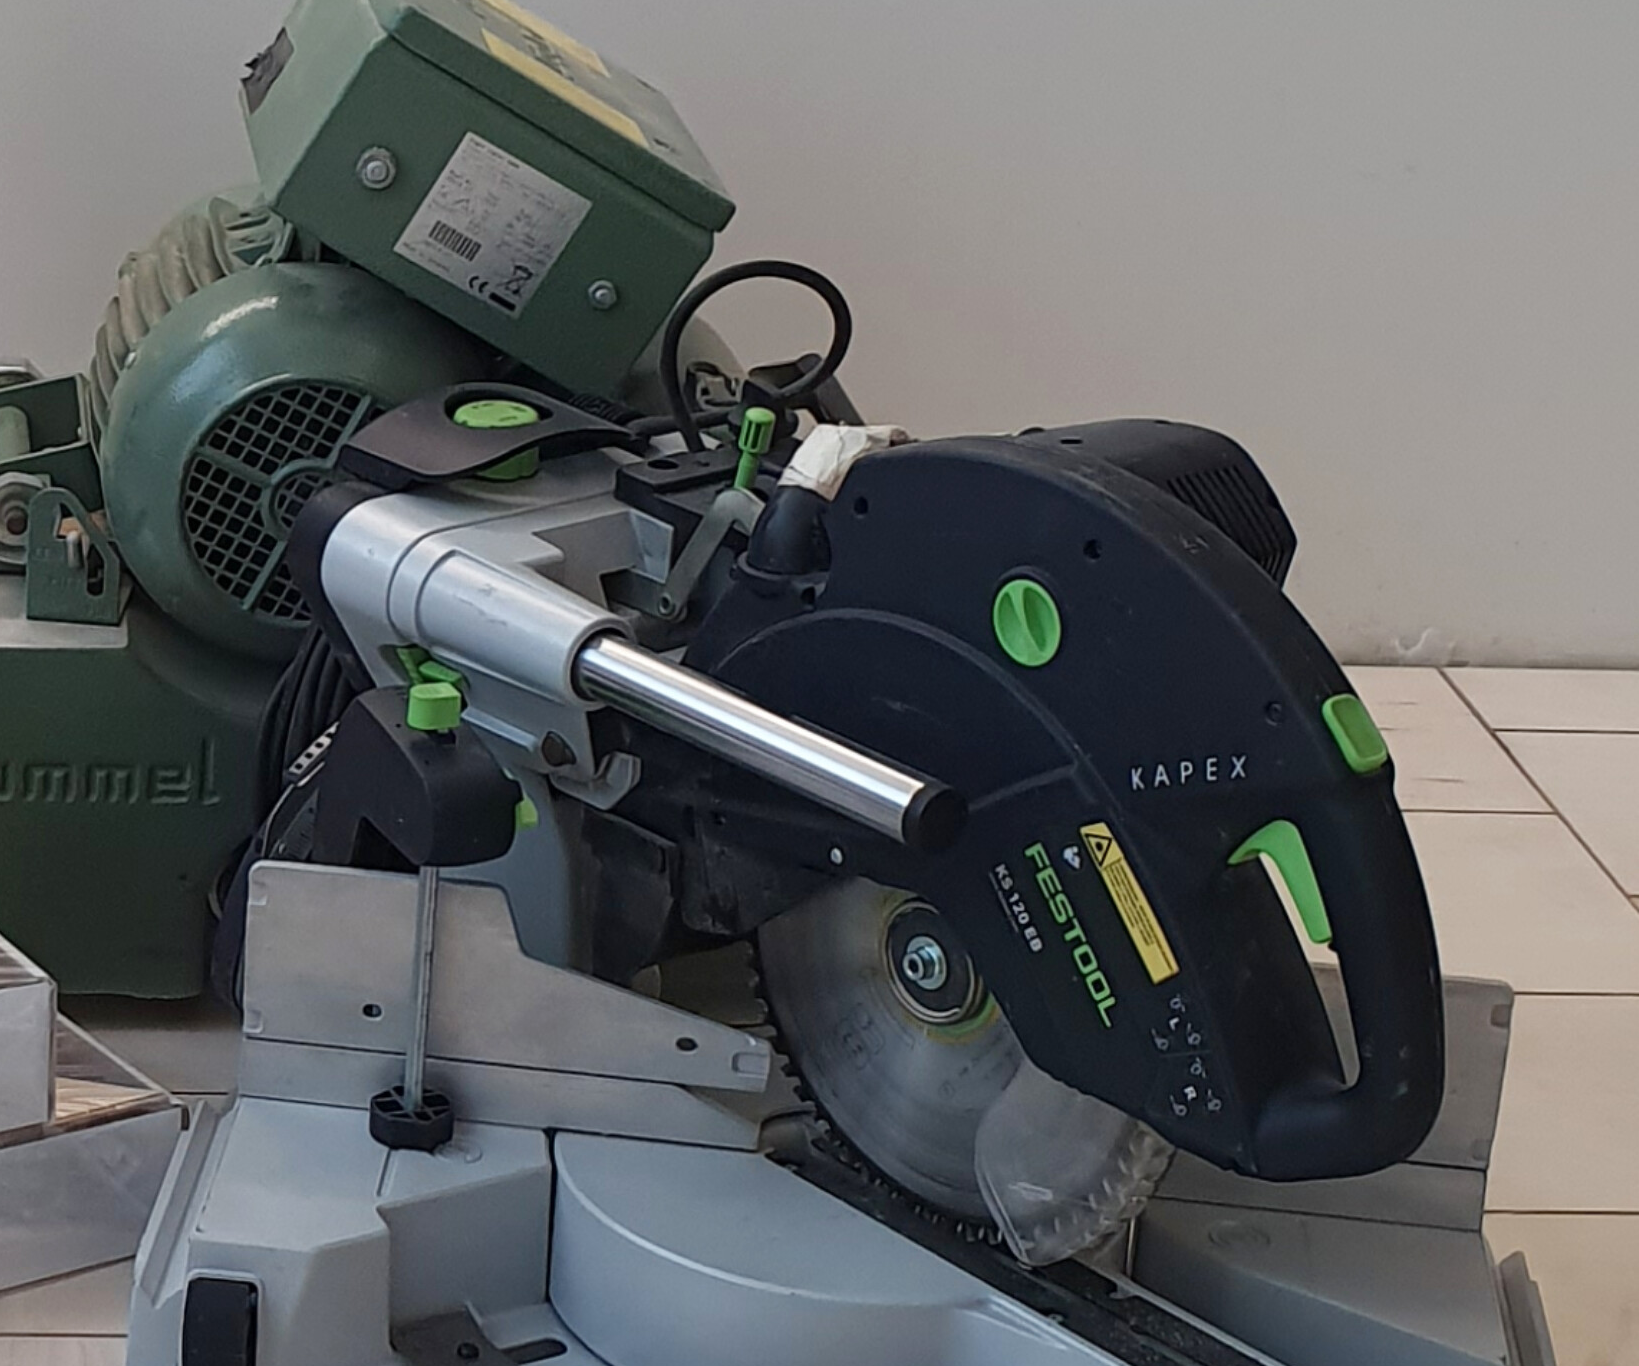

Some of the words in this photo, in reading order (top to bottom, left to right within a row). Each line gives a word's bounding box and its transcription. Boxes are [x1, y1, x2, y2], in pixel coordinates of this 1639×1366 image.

[1131, 755, 1248, 791] KAPEX
[994, 863, 1014, 891] KS
[1009, 892, 1030, 925] 120
[1024, 842, 1116, 1028] FESTOOL
